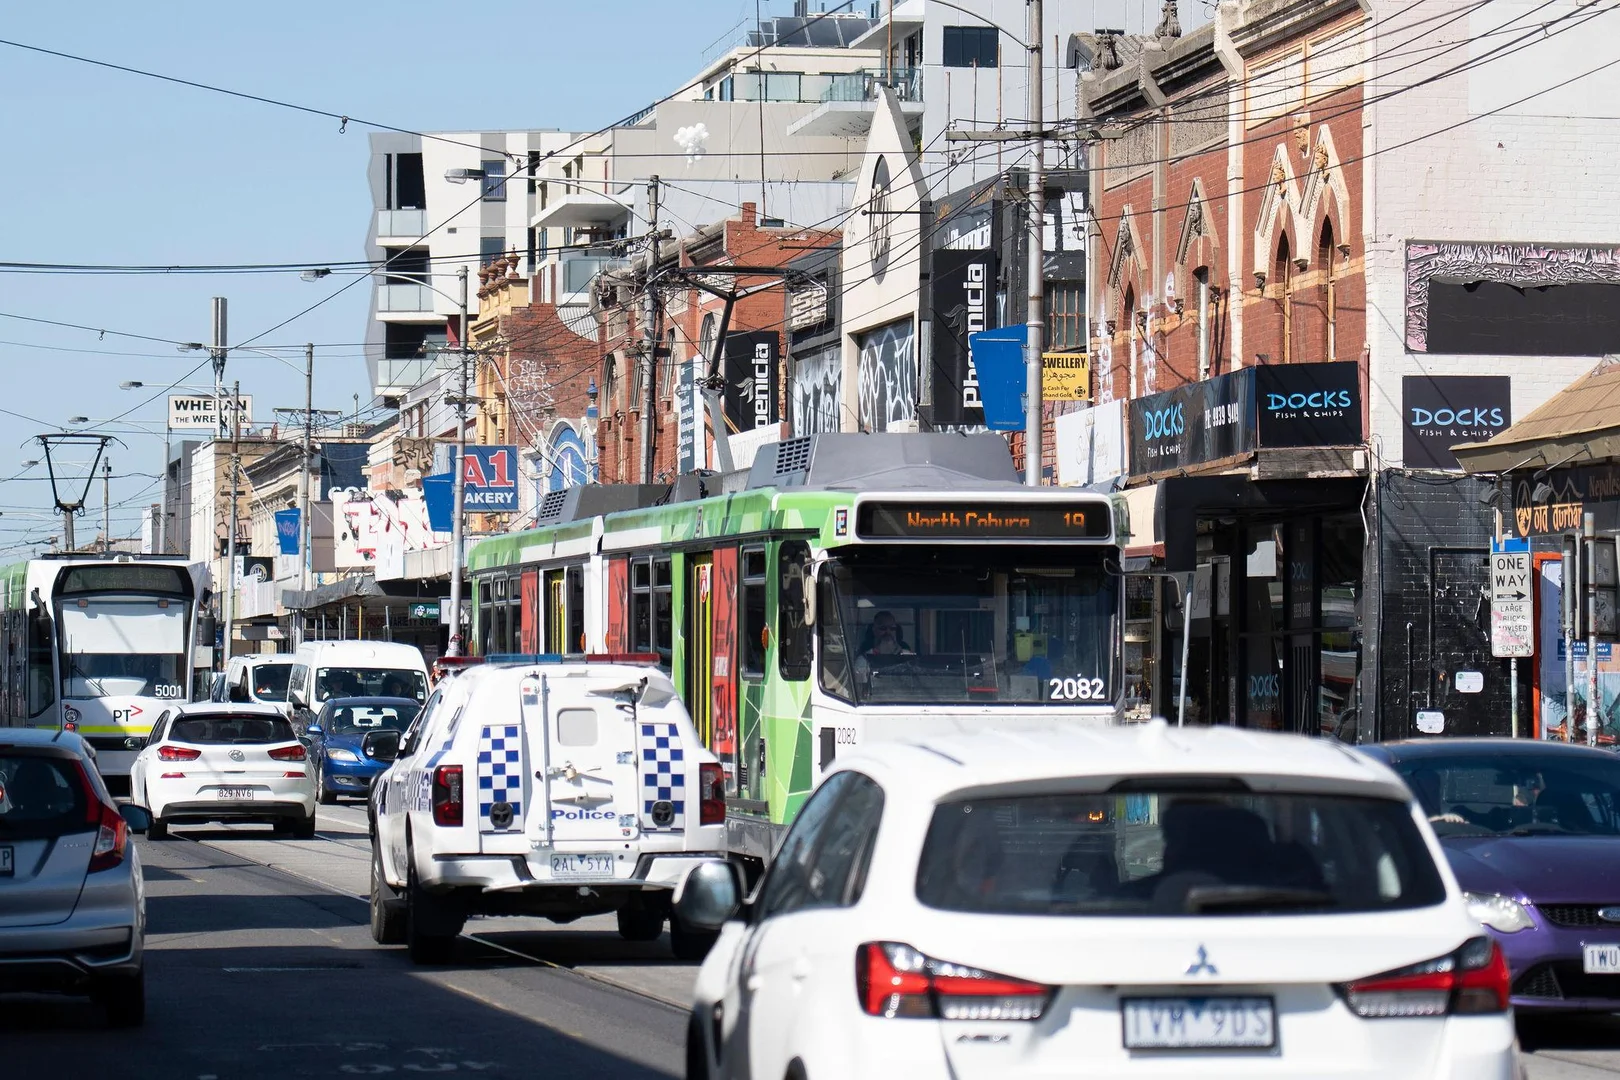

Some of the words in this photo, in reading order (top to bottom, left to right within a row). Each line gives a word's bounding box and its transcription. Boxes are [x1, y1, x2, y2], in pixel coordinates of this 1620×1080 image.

[1043, 358, 1086, 368] EWELLERY
[1266, 390, 1351, 410] DOCKS
[1145, 402, 1184, 440] DOCKS
[1411, 408, 1504, 426] DOCKS
[1148, 448, 1158, 458] FISH
[1160, 445, 1164, 455] &
[1166, 444, 1181, 455] CHIPS
[464, 450, 514, 488] A1
[464, 492, 514, 504] AKERY
[1064, 512, 1085, 527] 19
[1534, 505, 1548, 532] old
[1552, 503, 1583, 531] durbar
[1497, 558, 1524, 570] ONE
[1496, 574, 1526, 587] WAY
[155, 684, 182, 697] 5001
[1050, 678, 1105, 699] 2082
[1250, 674, 1279, 697] DOCKS
[113, 709, 131, 722] PT
[837, 728, 856, 745] 2082
[551, 809, 616, 820] Police
[553, 857, 576, 871] 2AL
[588, 857, 610, 870] 5YX
